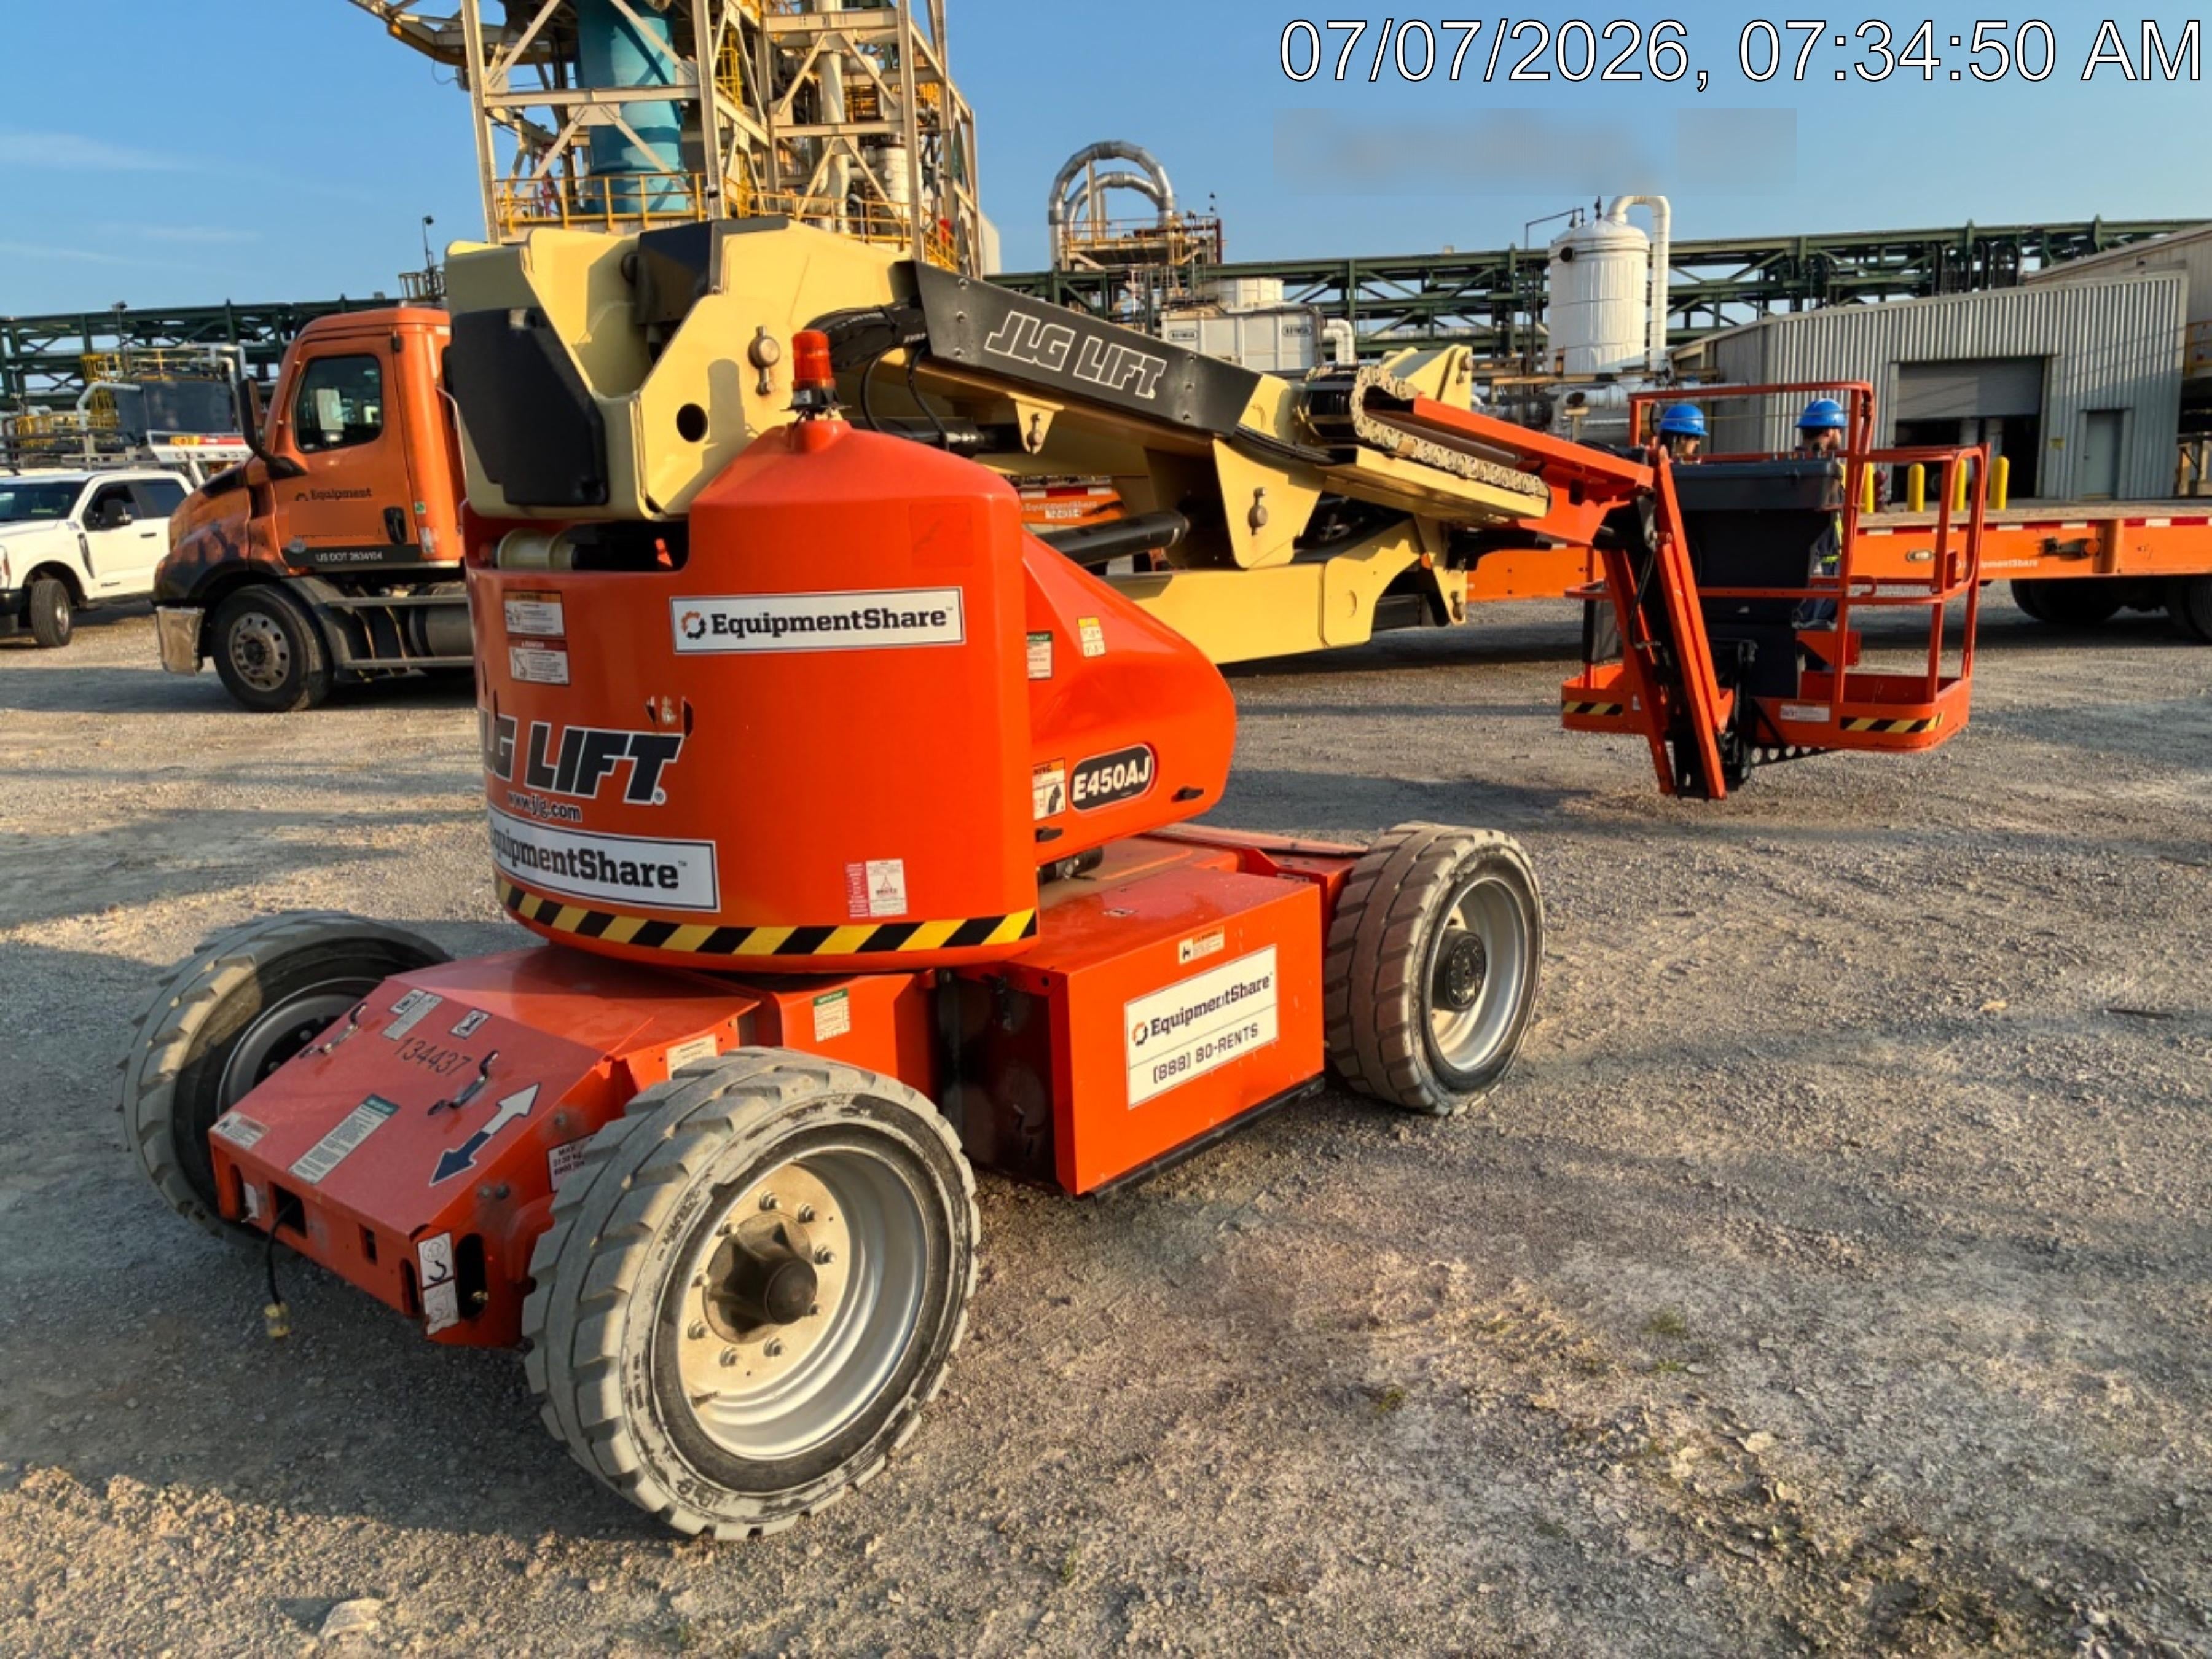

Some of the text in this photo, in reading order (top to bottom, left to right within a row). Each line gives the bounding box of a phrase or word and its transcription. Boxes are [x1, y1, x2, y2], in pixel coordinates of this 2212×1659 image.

[984, 310, 1167, 398] JLG LIFT
[711, 608, 946, 638] EquipmentShare
[525, 720, 684, 805] LIFT
[1072, 756, 1151, 802] E450AJ
[493, 828, 679, 890] quipmentShare
[1150, 975, 1270, 1037] EquipmentShare
[394, 1037, 472, 1077] 134437
